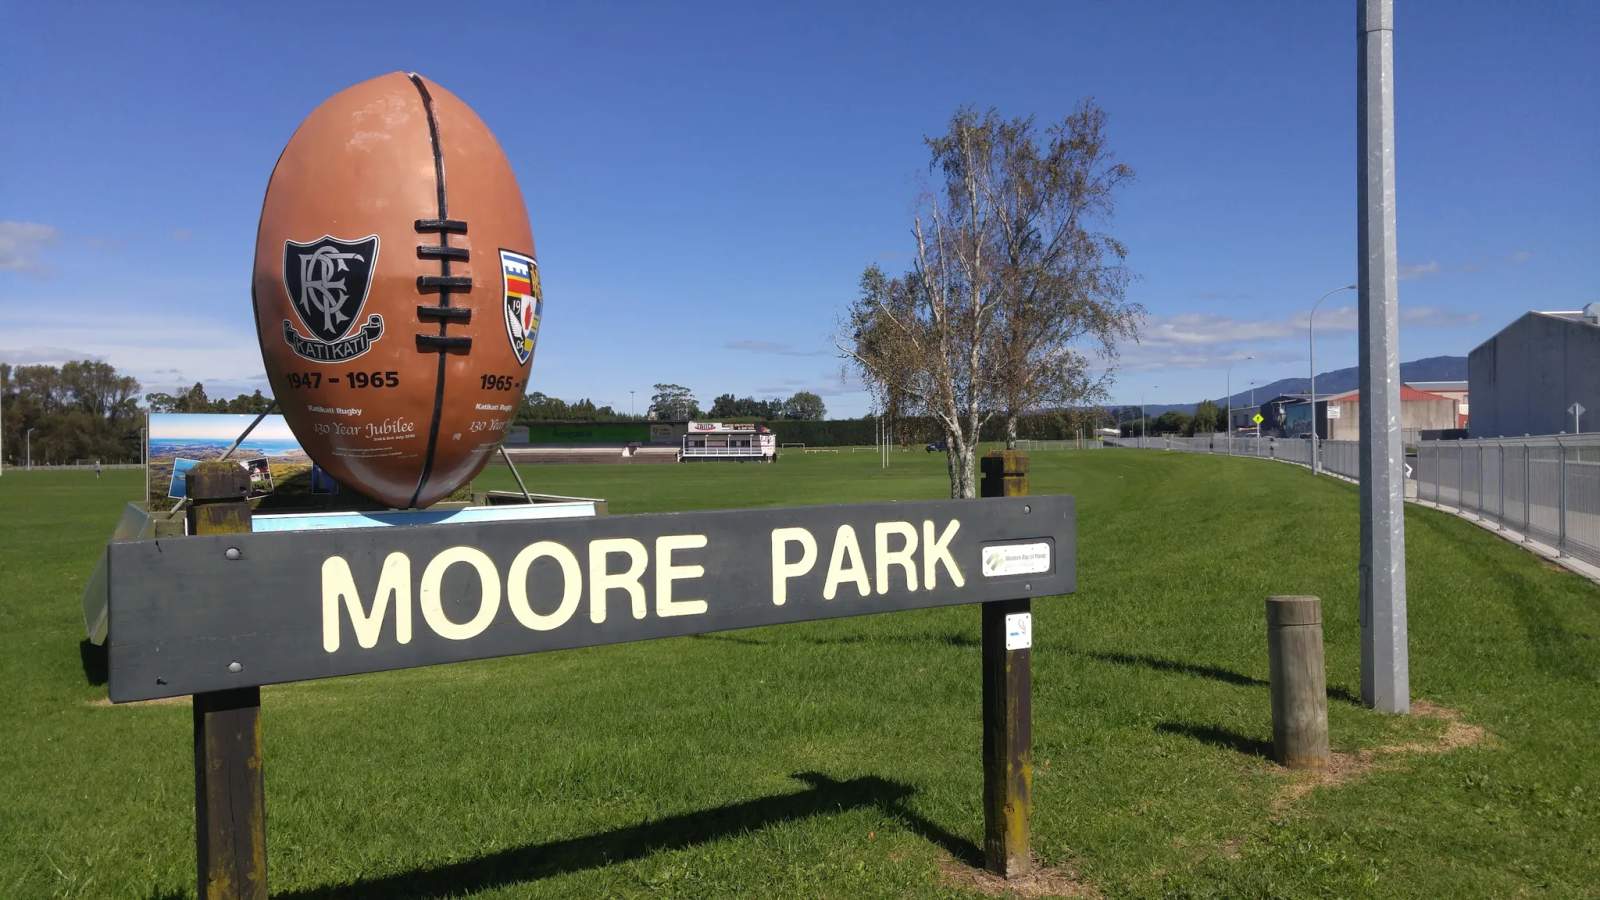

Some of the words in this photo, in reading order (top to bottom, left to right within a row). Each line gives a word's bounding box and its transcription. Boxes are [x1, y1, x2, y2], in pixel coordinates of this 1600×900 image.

[287, 372, 322, 389] 1947
[346, 371, 400, 389] 1965
[480, 374, 513, 391] 1965
[336, 407, 362, 416] Rugby
[332, 421, 362, 436] Year
[365, 416, 415, 439] Jubilee
[470, 420, 487, 433] 130
[321, 534, 709, 653] MOORE
[771, 519, 966, 607] PARK
